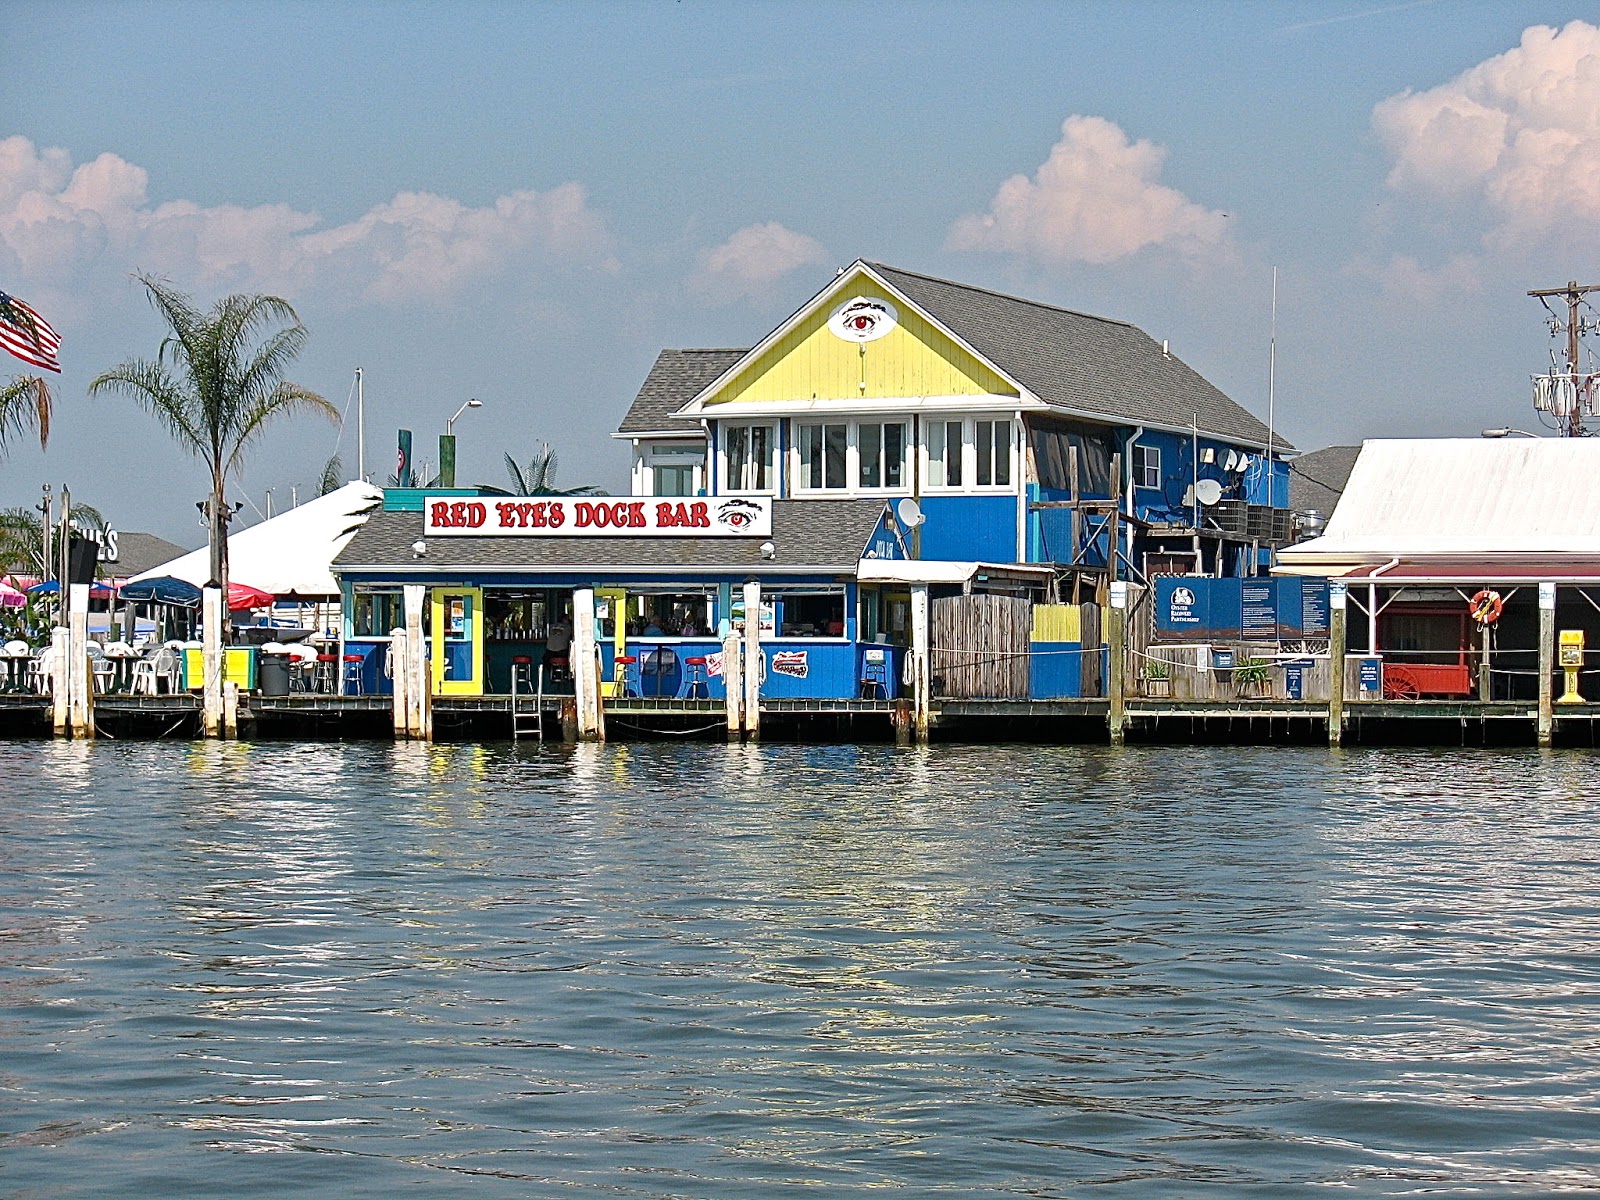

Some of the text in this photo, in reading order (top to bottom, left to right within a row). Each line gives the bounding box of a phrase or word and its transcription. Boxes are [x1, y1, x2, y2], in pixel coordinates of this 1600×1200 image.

[431, 501, 711, 529] RED EYE'S DOCK BAR
